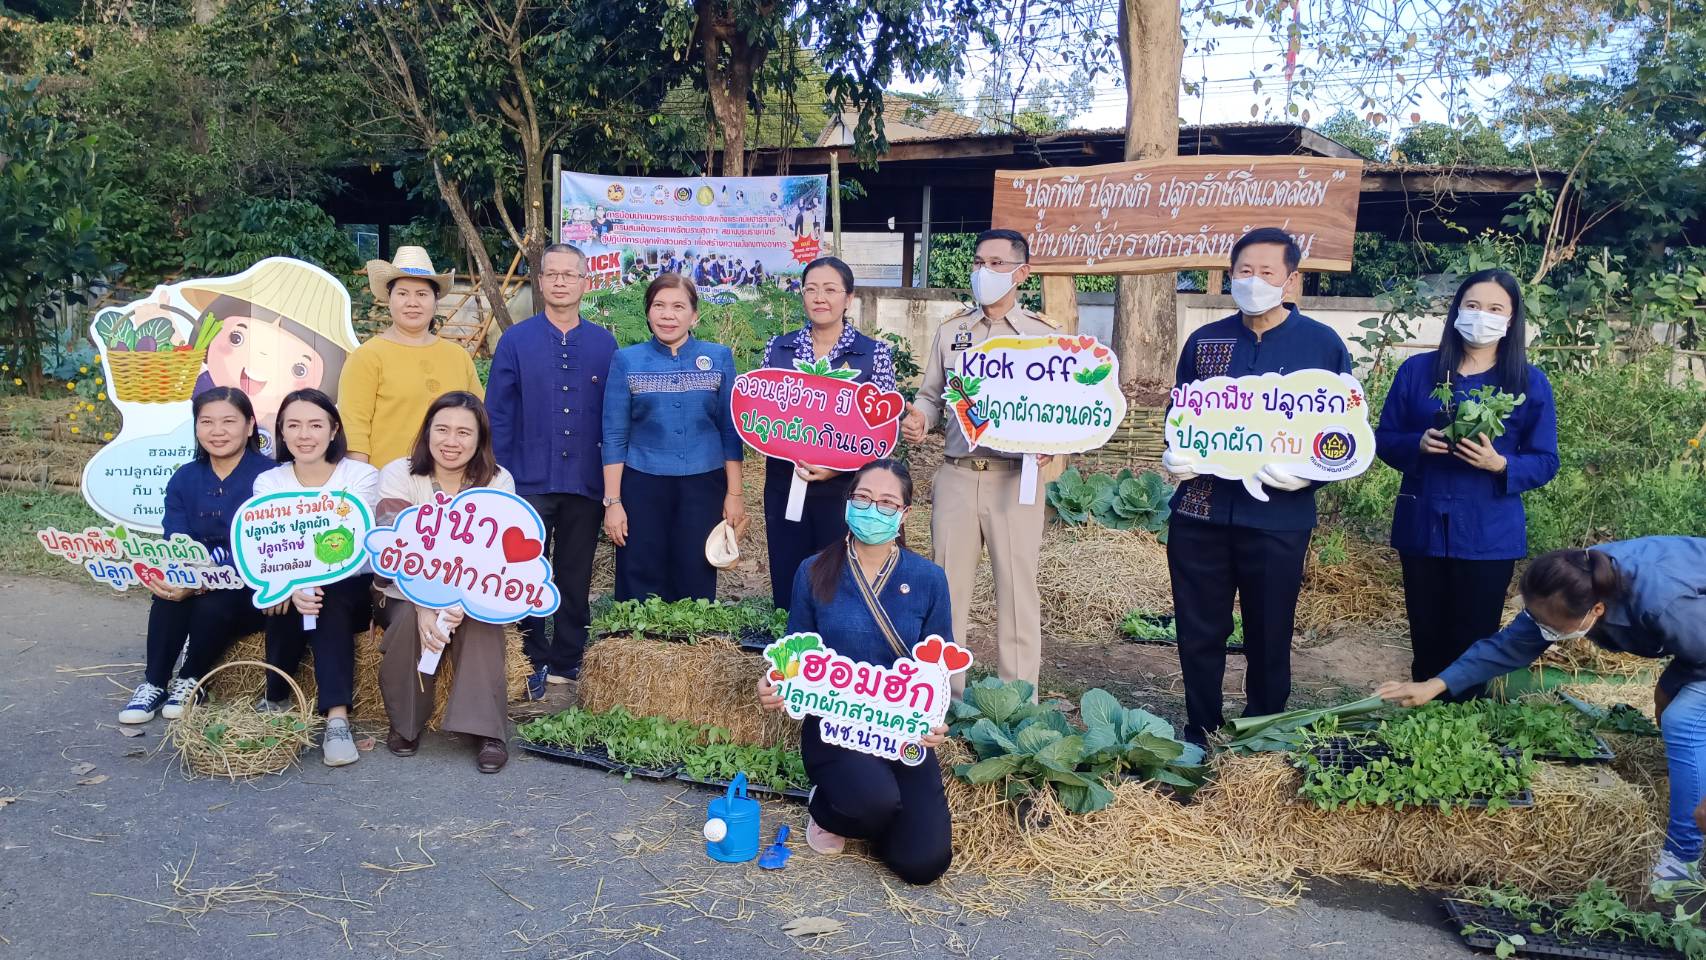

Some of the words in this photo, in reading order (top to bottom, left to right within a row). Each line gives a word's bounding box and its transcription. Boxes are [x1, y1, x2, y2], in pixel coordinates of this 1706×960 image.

[1089, 172, 1151, 219] ปลูกผัก
[962, 352, 1014, 379] Kick
[1026, 355, 1077, 382] off
[735, 373, 827, 413] จวนผู้ว่าฯ
[836, 391, 852, 415] มี
[863, 388, 892, 419] รัก
[977, 394, 1112, 428] ปลูกผักสวนครัว
[1172, 383, 1254, 416] ปลูกพืช
[1262, 387, 1346, 420] ปลูกรัก
[1176, 425, 1263, 458] ปลูกผัก
[1270, 431, 1303, 454] กับ
[105, 465, 173, 479] มาปลูกผัก
[132, 484, 152, 496] กับ
[244, 504, 291, 522] คนน่าน
[296, 494, 335, 514] ร่วมใจ
[415, 492, 498, 551] ผู้นำ
[245, 520, 286, 542] ปลูกพืช
[290, 515, 330, 534] ปลูกผัก
[41, 530, 118, 561] ปลูกพืช
[122, 536, 206, 564] ปลูกผัก
[258, 536, 305, 558] ปลูกรักษ์
[89, 561, 134, 587] ปลูก
[166, 563, 196, 584] กับ
[201, 569, 239, 586] พช.
[260, 558, 312, 574] สิ่งแวดล้อม
[380, 538, 543, 608] ต้องทำก่อน
[803, 654, 935, 713] ฮอมฮัก
[774, 682, 931, 737] ปลูกผักสวนครัว
[824, 721, 897, 754] พช.น่าน
